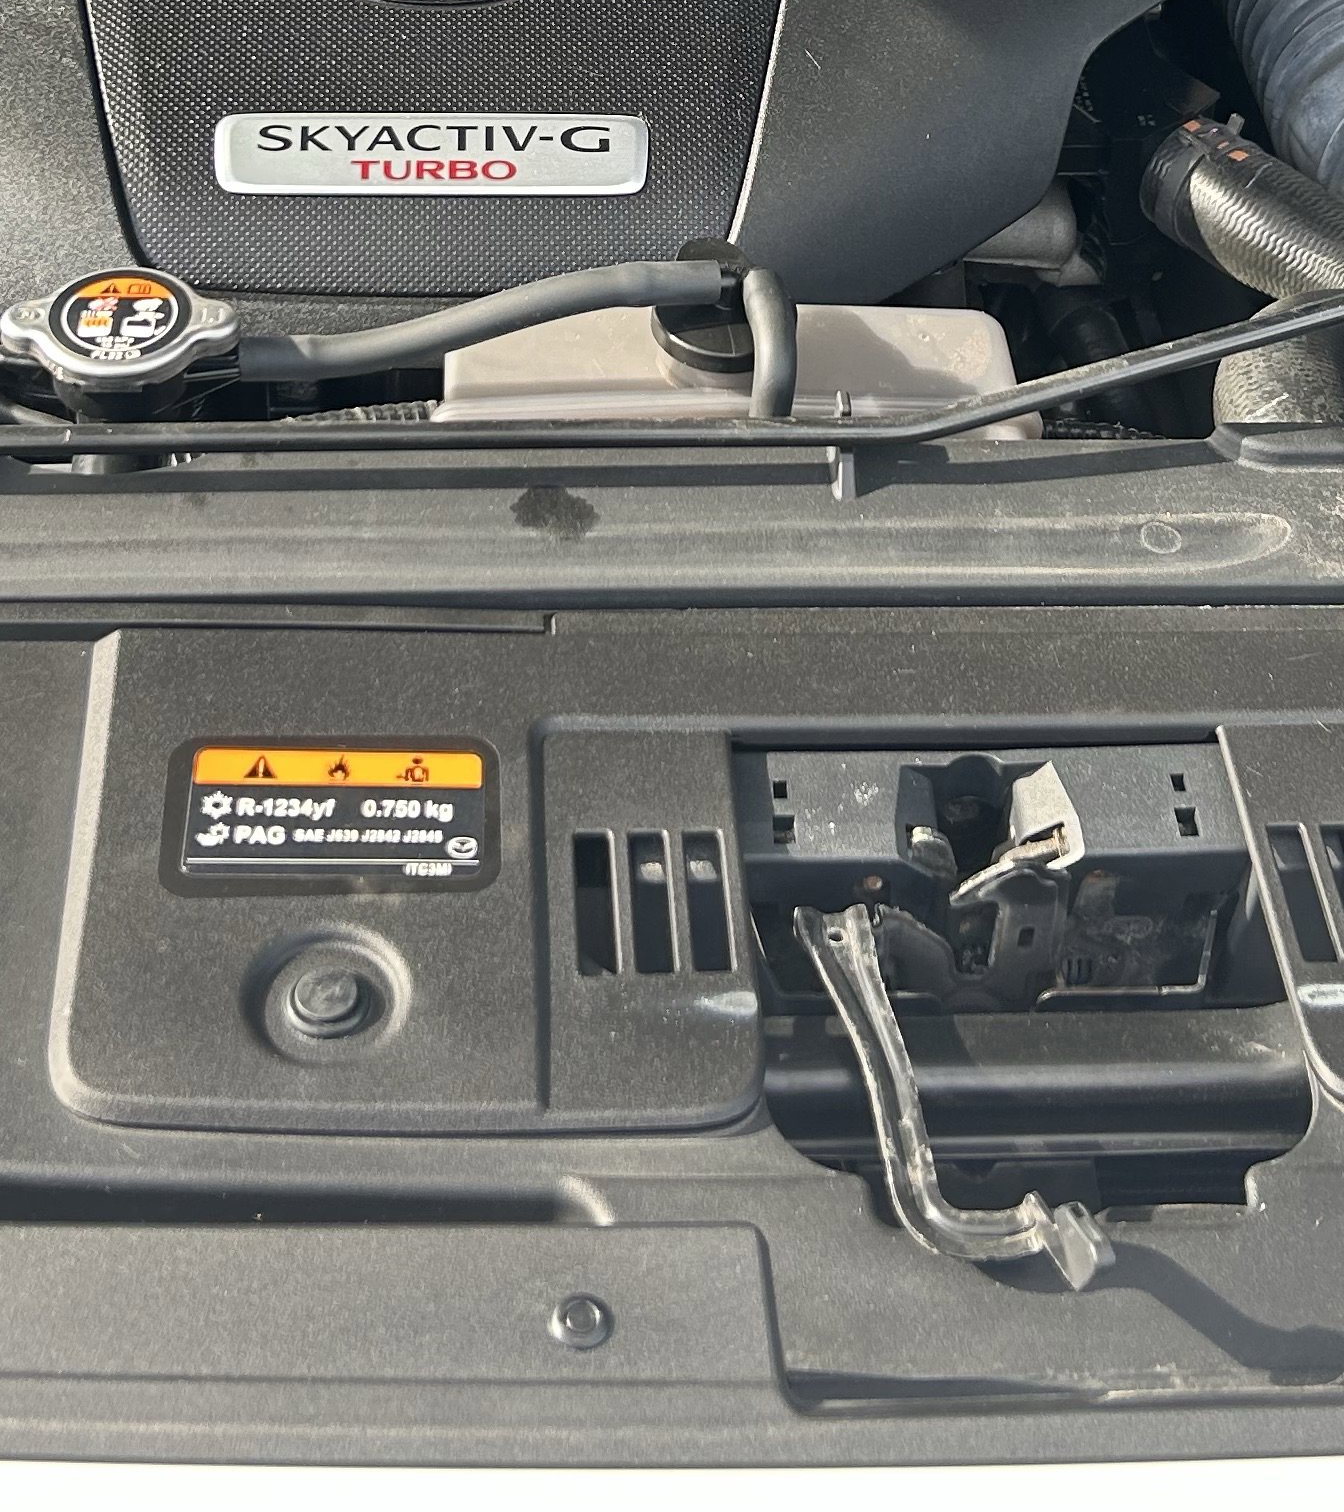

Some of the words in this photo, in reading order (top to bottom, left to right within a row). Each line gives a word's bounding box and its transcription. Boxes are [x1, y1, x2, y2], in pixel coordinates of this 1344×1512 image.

[257, 124, 612, 153] SKYACTIV-G
[350, 159, 517, 181] TURBO
[236, 797, 336, 821] R-1234yf
[360, 799, 421, 818] 0.750
[423, 800, 454, 823] kg
[233, 825, 286, 845] PAG
[293, 828, 325, 843] SAE
